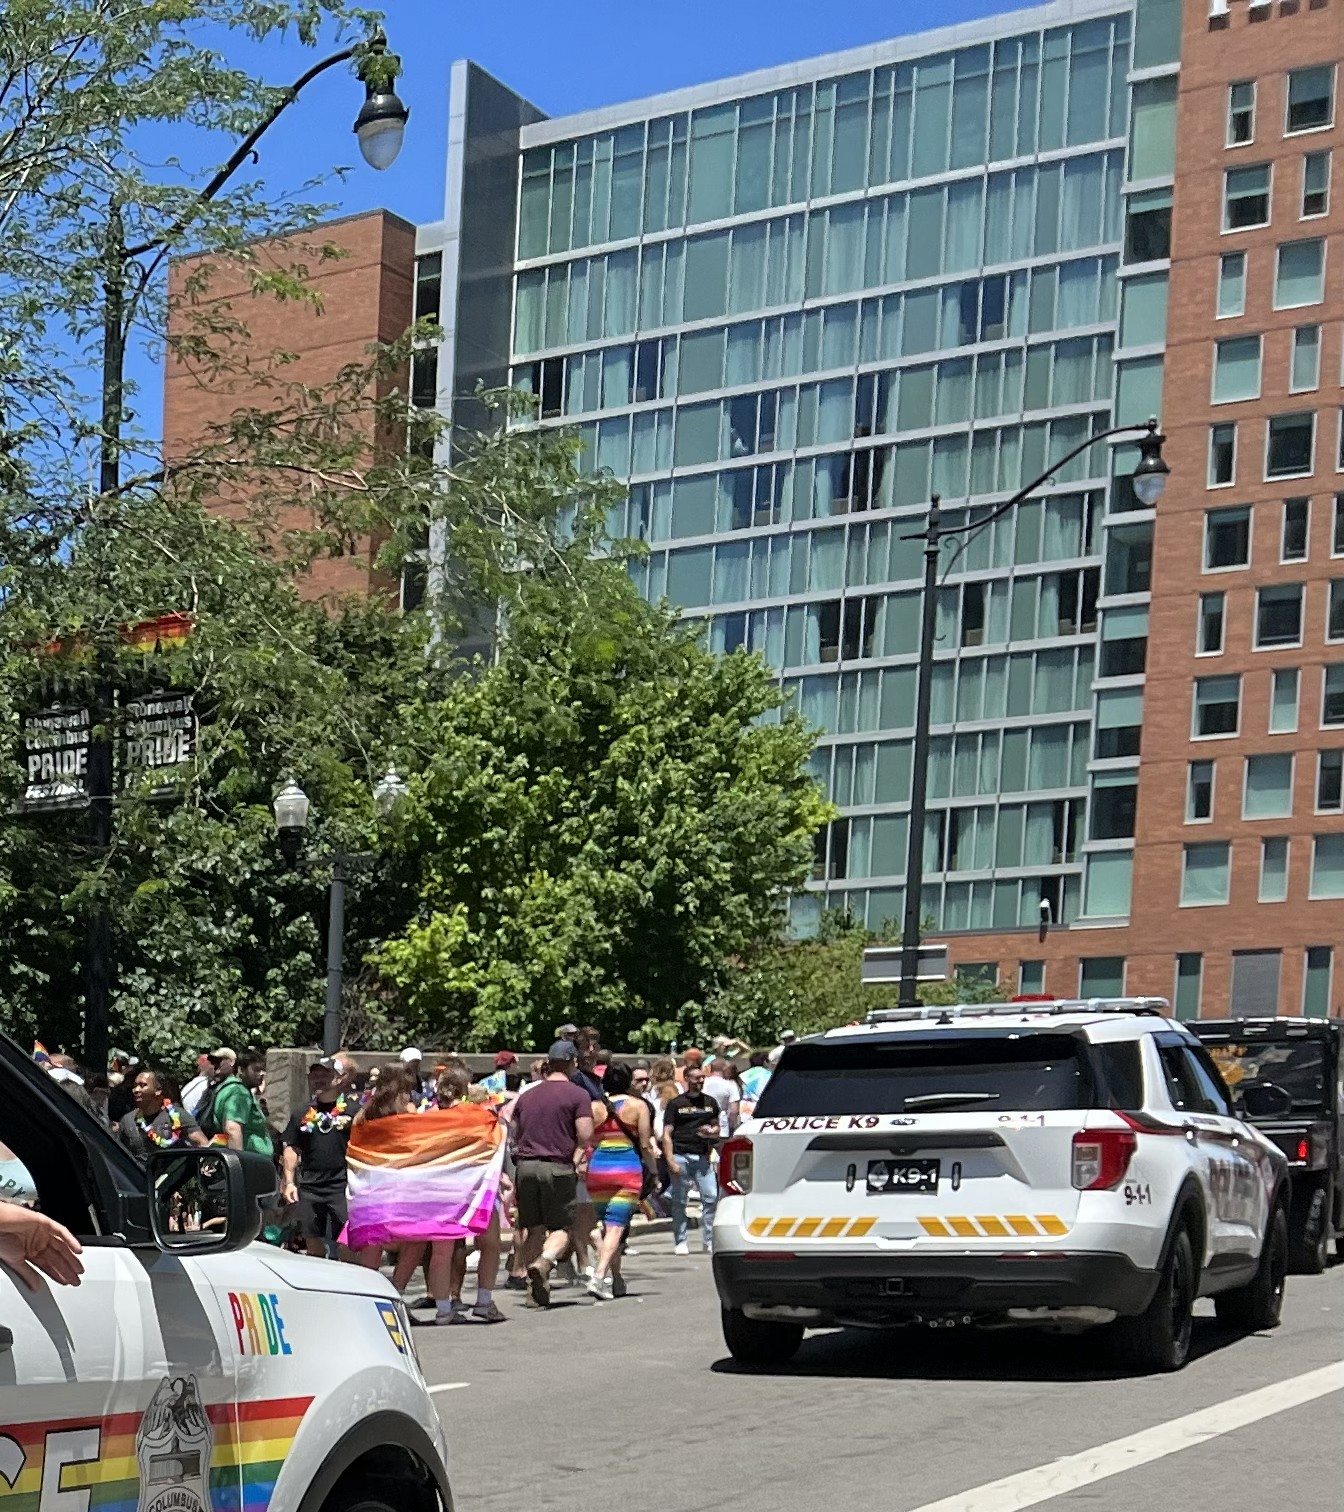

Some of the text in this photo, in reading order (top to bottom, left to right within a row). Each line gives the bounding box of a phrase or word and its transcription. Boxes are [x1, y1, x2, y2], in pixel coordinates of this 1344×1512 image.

[28, 748, 88, 781] PRIDE
[127, 733, 191, 766] PRIDE
[759, 1115, 841, 1133] POLICE
[848, 1114, 880, 1129] K9
[893, 1168, 937, 1184] K9-1
[227, 1292, 293, 1356] PRIDE
